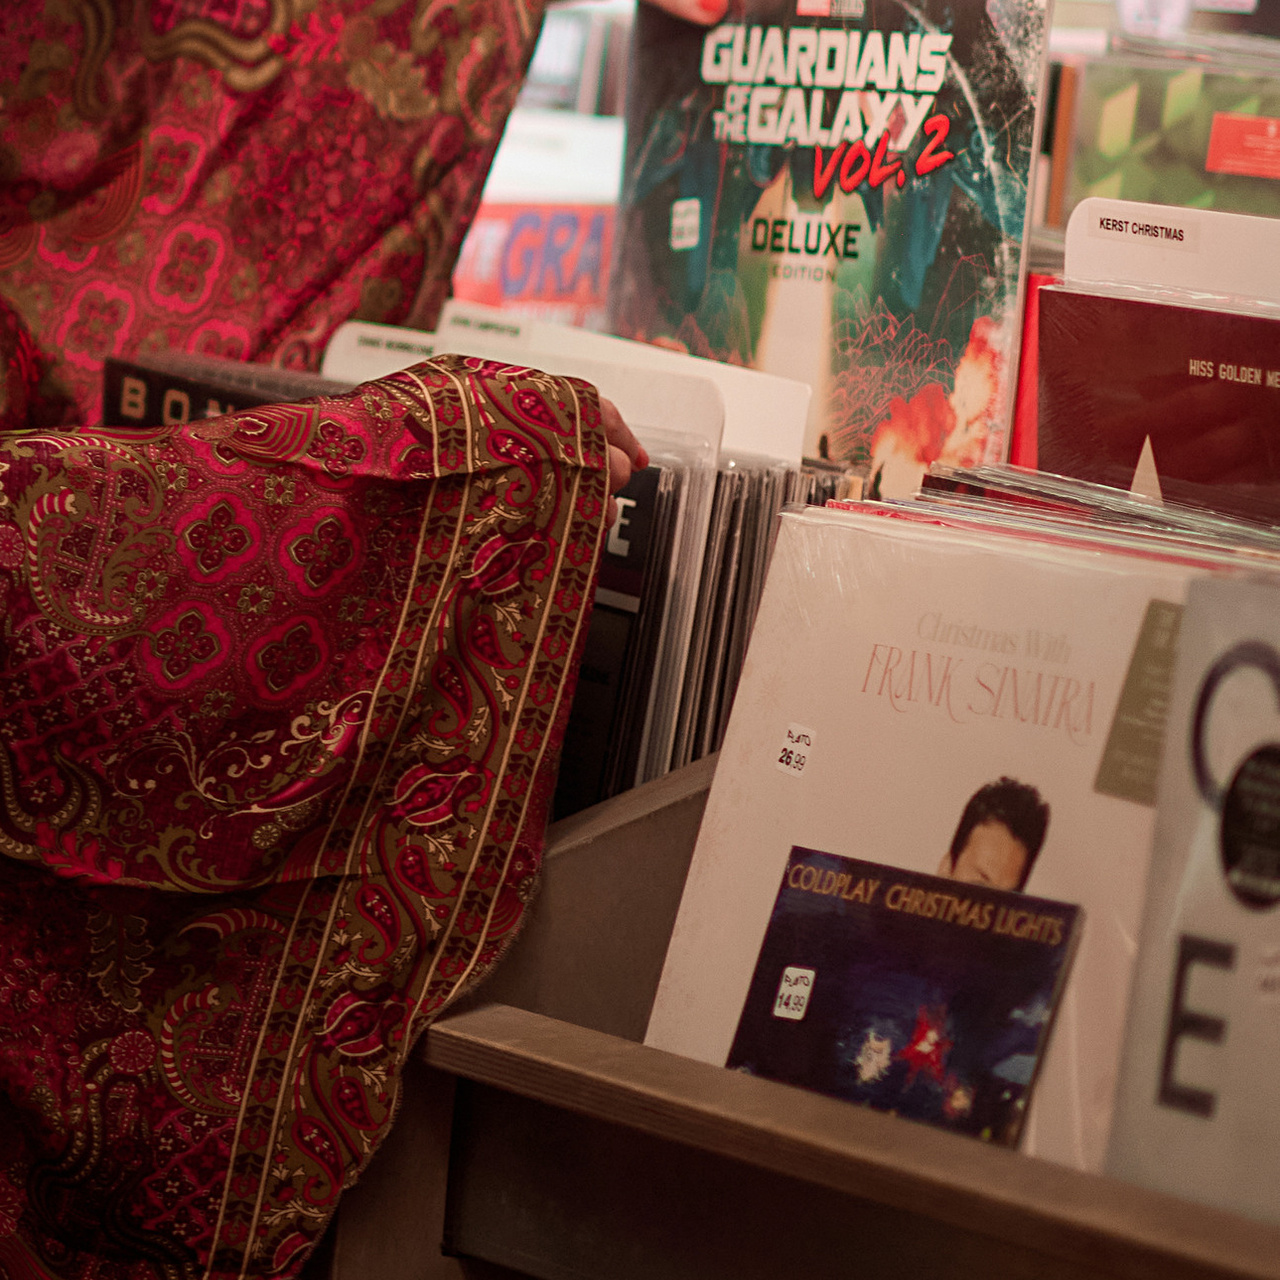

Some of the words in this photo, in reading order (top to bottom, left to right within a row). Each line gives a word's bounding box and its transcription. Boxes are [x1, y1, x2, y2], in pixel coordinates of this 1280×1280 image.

[701, 24, 954, 93] GUARDIANS
[713, 111, 747, 142] THE
[747, 86, 935, 152] GALAXY
[724, 84, 751, 113] OF
[814, 131, 906, 198] VOL.
[915, 114, 954, 176] 2
[751, 218, 861, 259] DELUXE
[1099, 217, 1130, 233] KERST
[1131, 222, 1185, 242] CHRISTMAS
[772, 264, 836, 282] EDITION
[1188, 358, 1214, 378] HISS
[1219, 363, 1263, 386] GOLDEN
[917, 612, 1018, 655] Christmas
[1023, 628, 1071, 665] With
[861, 643, 967, 724] FRANK
[968, 662, 1096, 747] SINATRA
[788, 864, 880, 904] COLDPLAY
[885, 883, 994, 930] CHRISTMAS
[993, 907, 1065, 946] LIGHTS
[1157, 933, 1237, 1119] E
